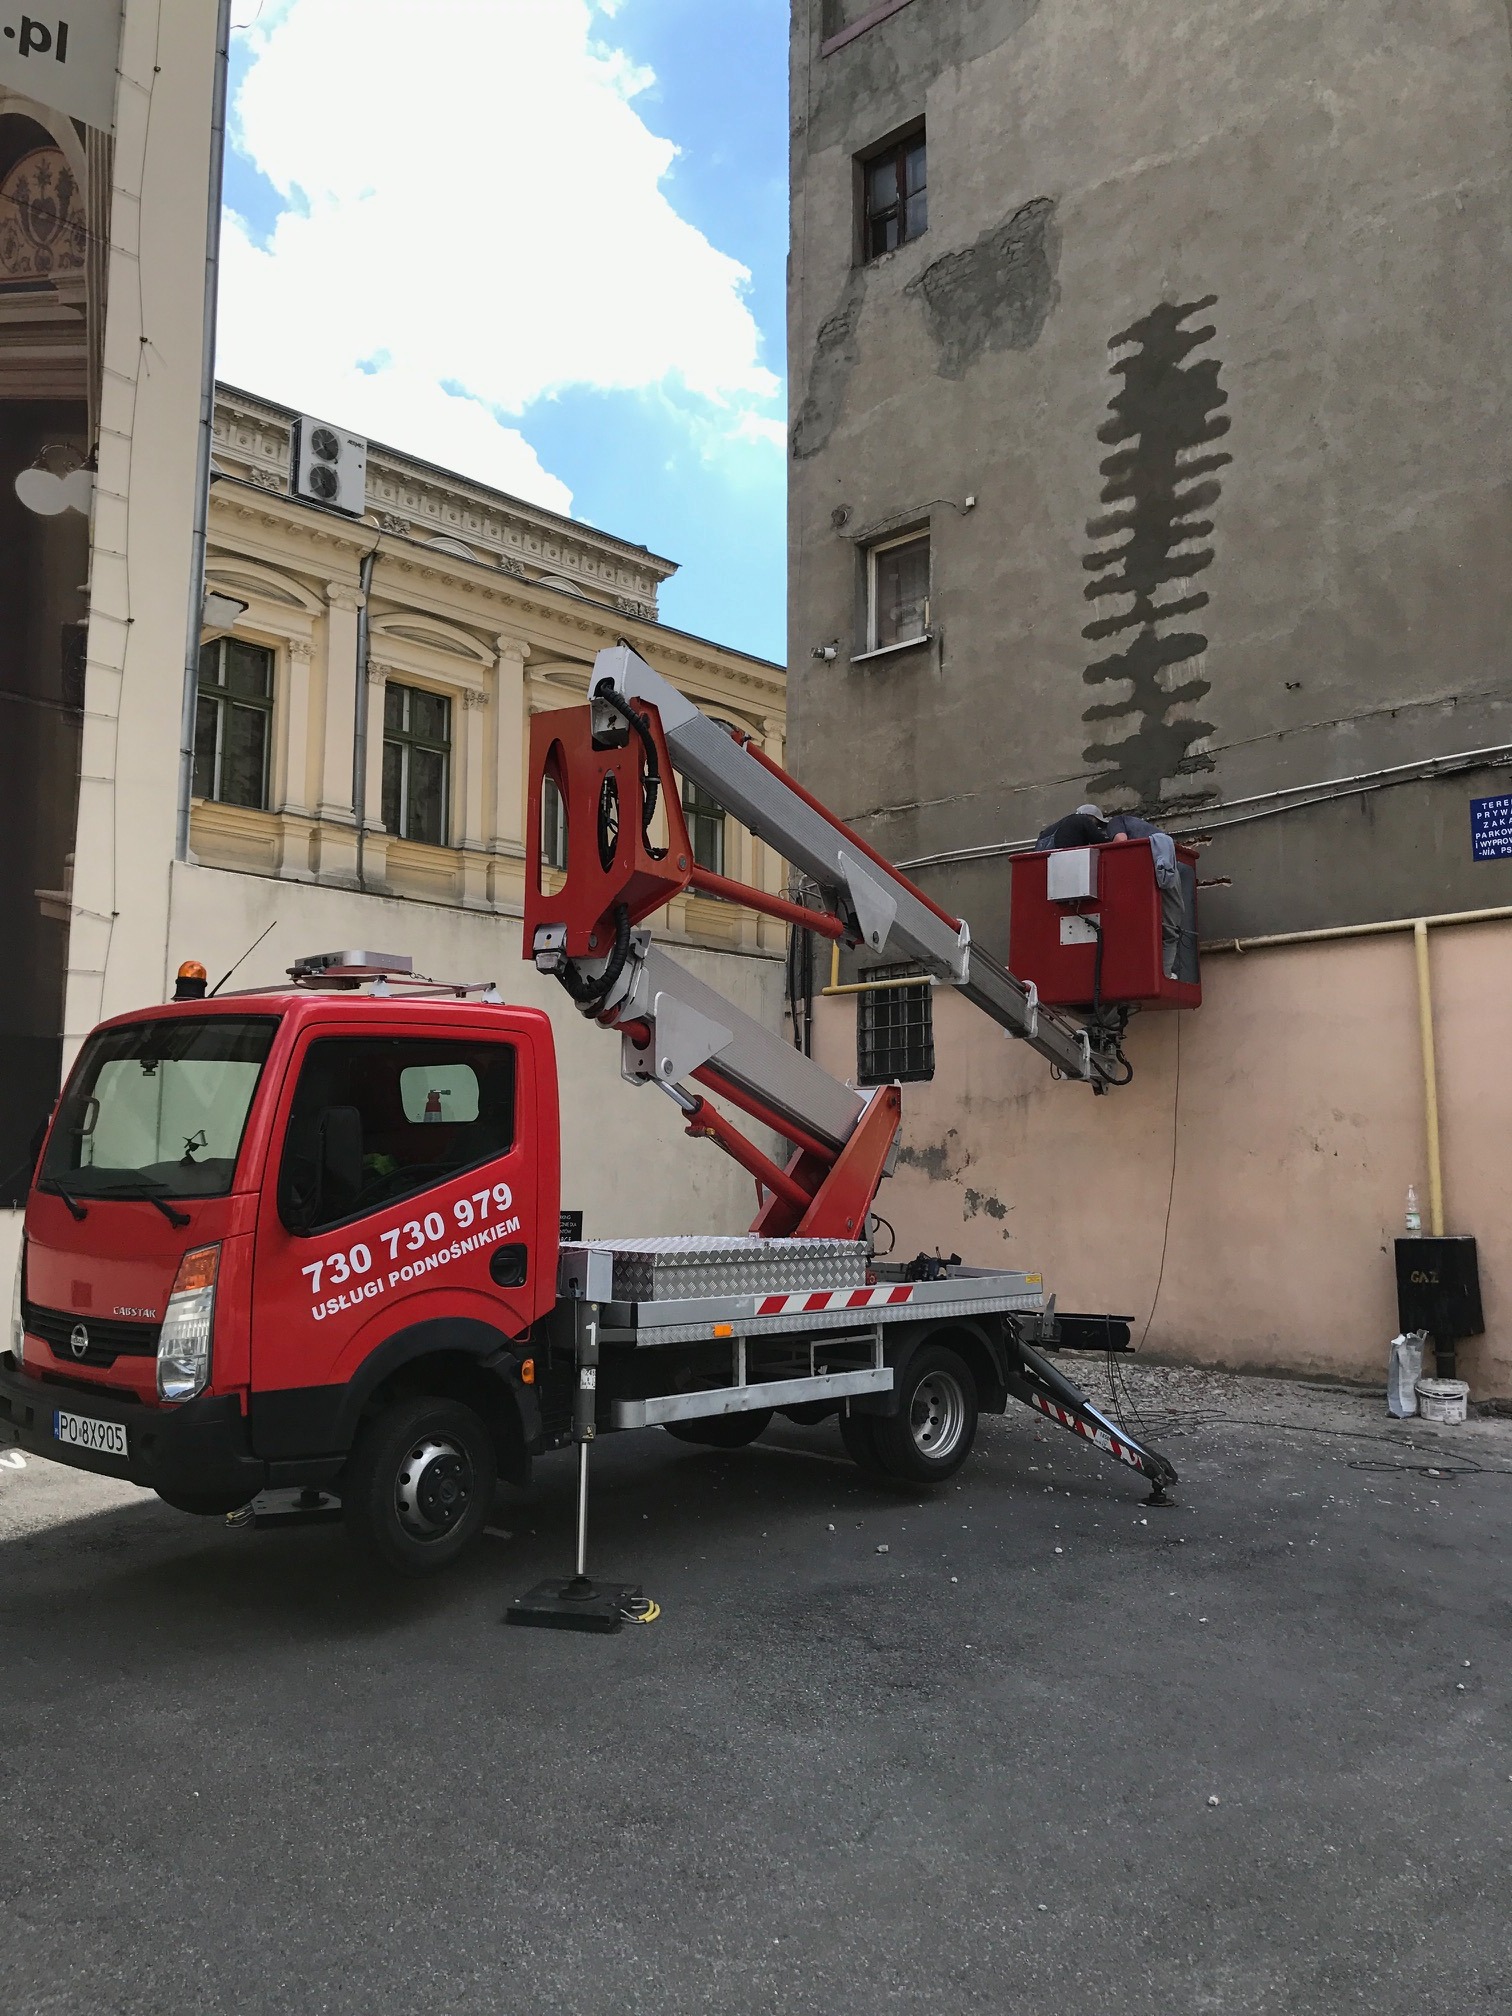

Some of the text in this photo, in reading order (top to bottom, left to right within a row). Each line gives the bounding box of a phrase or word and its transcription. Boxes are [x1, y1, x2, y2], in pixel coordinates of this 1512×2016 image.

[3, 15, 69, 64] .pl
[1476, 808, 1512, 820] PRYW
[1481, 799, 1512, 810] TERE
[301, 1182, 513, 1294] 730 730 979
[311, 1216, 521, 1321] USŁUGI PODNOŚNIKIEM
[1410, 1270, 1439, 1284] GAZ
[586, 1321, 596, 1346] 1
[61, 1414, 124, 1452] PO 8X905
